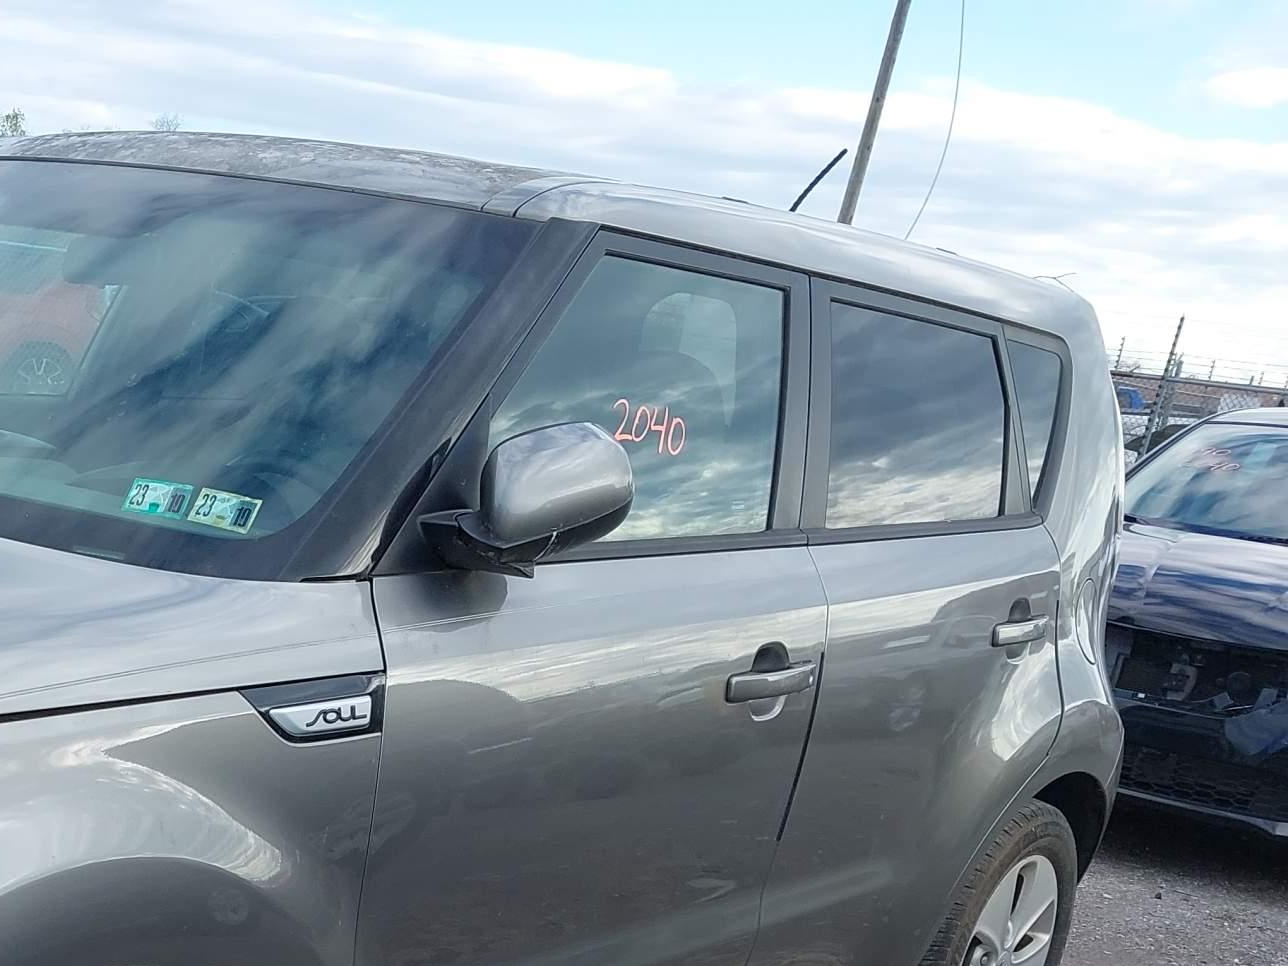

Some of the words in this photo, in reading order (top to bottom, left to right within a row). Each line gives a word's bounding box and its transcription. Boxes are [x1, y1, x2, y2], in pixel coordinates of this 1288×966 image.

[612, 398, 686, 455] 2040
[129, 483, 149, 506] 23
[195, 493, 217, 518] 23
[306, 705, 367, 727] SOUL
